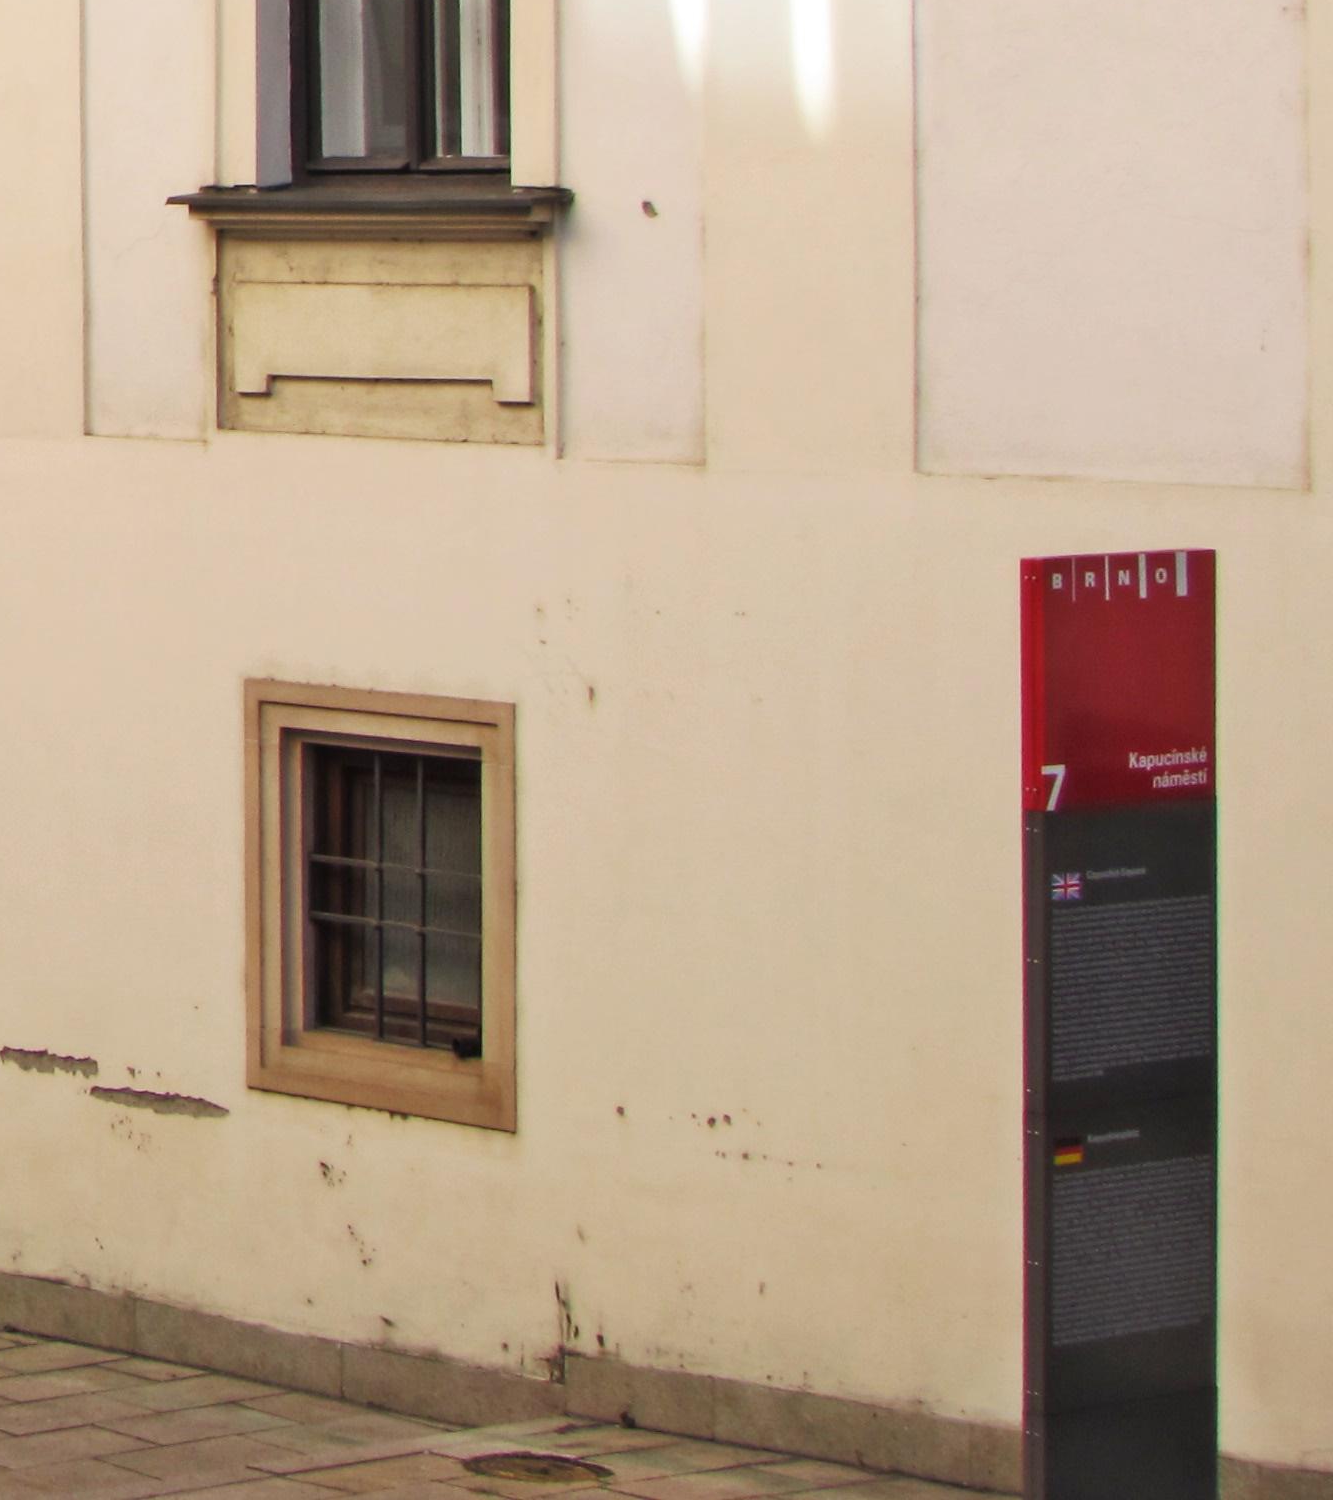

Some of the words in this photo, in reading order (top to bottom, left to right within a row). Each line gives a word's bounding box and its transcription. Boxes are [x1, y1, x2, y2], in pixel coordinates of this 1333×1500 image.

[1051, 567, 1168, 590] BRNO
[1128, 746, 1208, 771] Kapucínské
[1041, 764, 1066, 812] 7
[1152, 767, 1208, 789] náměstí
